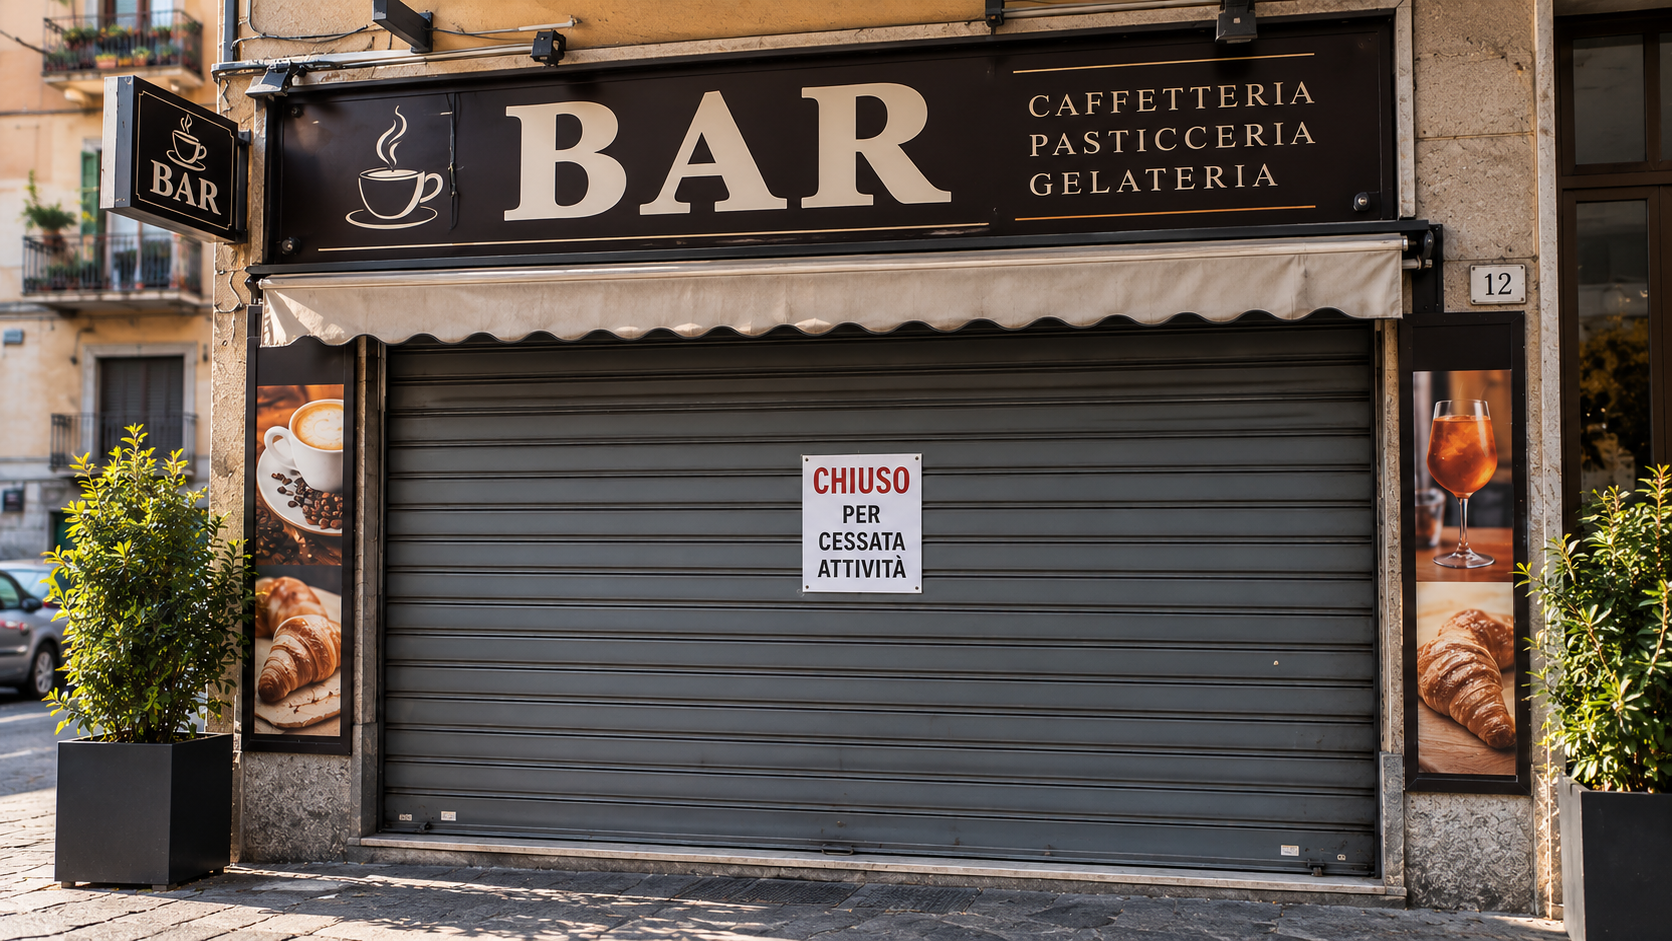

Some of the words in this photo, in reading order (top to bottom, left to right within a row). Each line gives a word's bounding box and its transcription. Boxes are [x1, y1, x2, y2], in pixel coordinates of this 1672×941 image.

[1028, 81, 1315, 118] CAFFETTERIA
[503, 82, 952, 222] BAR
[1029, 121, 1316, 157] PASTICCERIA
[149, 158, 222, 216] BAR
[1029, 163, 1278, 197] GELATERIA
[1484, 272, 1513, 296] 12
[812, 466, 910, 495] CHIUSO
[842, 504, 881, 524] PER
[818, 531, 906, 551] CESSATA
[817, 555, 907, 579] ATTIVITÀ
